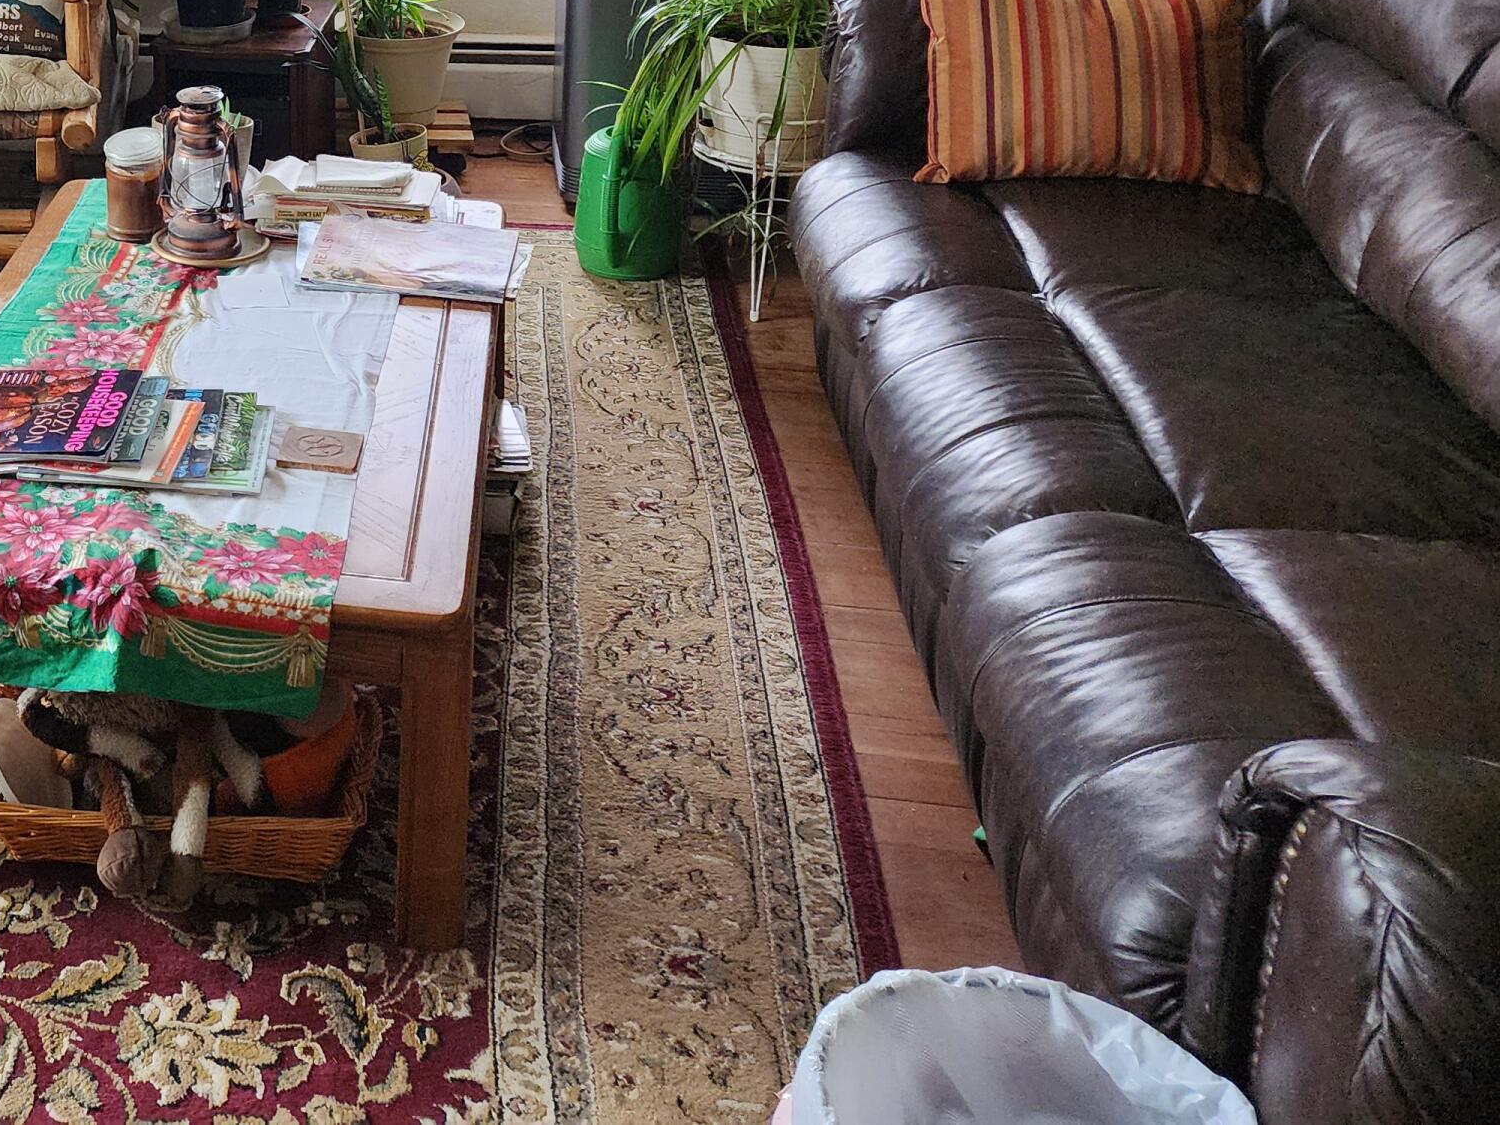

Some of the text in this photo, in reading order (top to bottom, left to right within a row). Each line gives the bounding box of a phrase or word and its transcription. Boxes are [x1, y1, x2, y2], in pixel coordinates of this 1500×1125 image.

[312, 244, 331, 266] REAL
[23, 396, 65, 444] SEASON
[49, 401, 80, 435] COZY
[64, 369, 120, 452] HOUSEKEEPING
[96, 391, 128, 427] GOOD
[129, 398, 158, 435] GOOD
